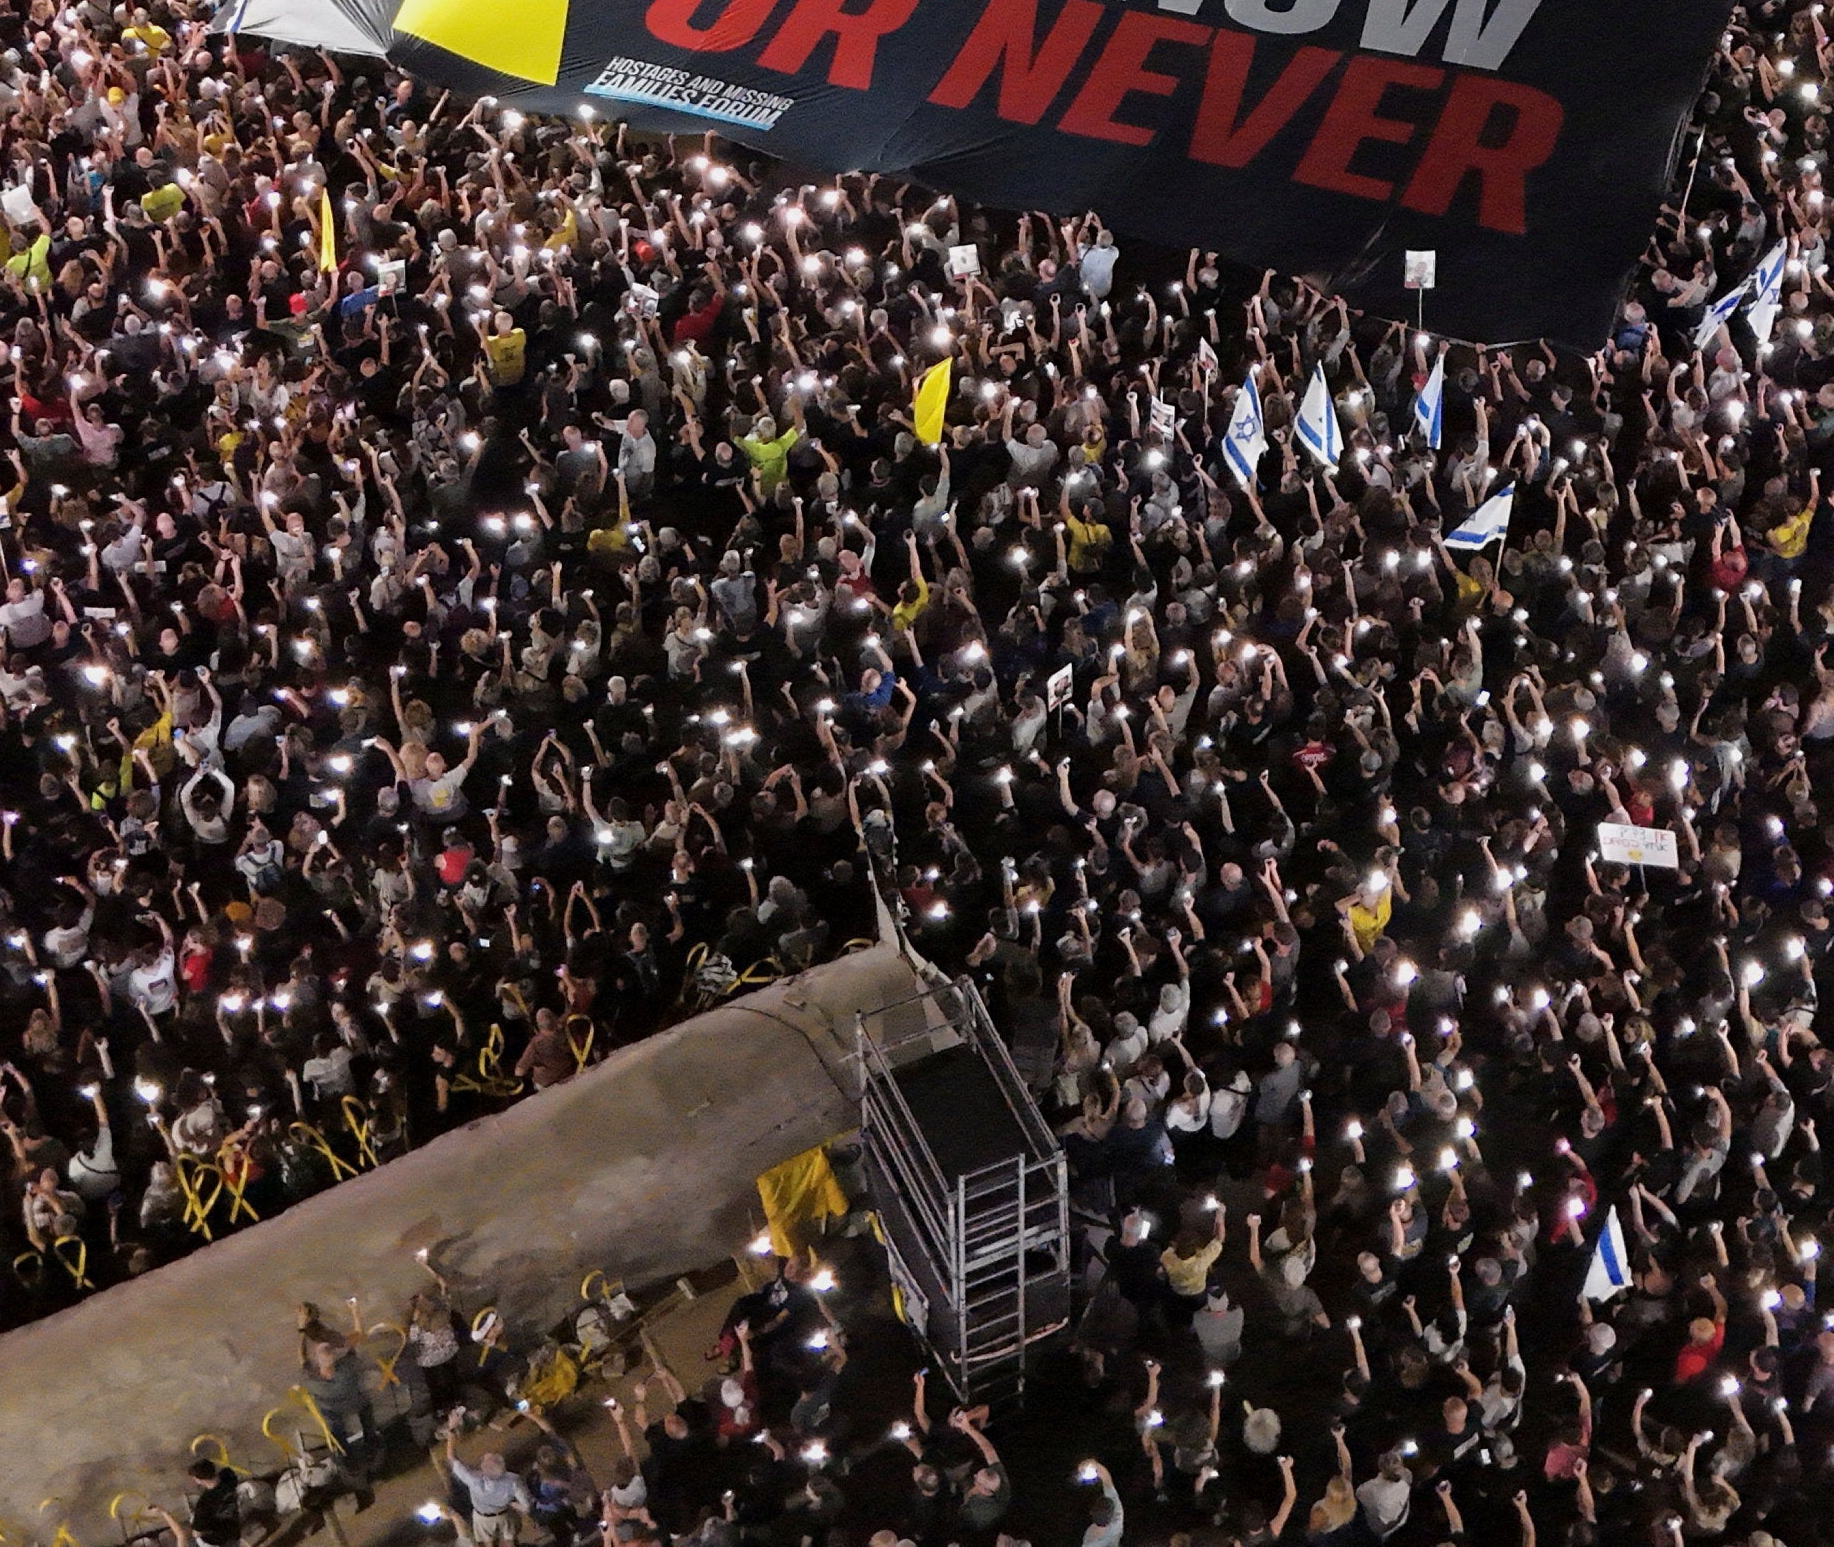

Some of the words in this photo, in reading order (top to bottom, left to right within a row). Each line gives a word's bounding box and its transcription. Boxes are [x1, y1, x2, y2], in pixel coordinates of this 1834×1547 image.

[594, 70, 698, 106] FAMILIES
[695, 95, 782, 128] FORUM
[606, 56, 690, 86] HOSTAGES
[686, 75, 725, 95] AND
[724, 84, 794, 111] MISSING
